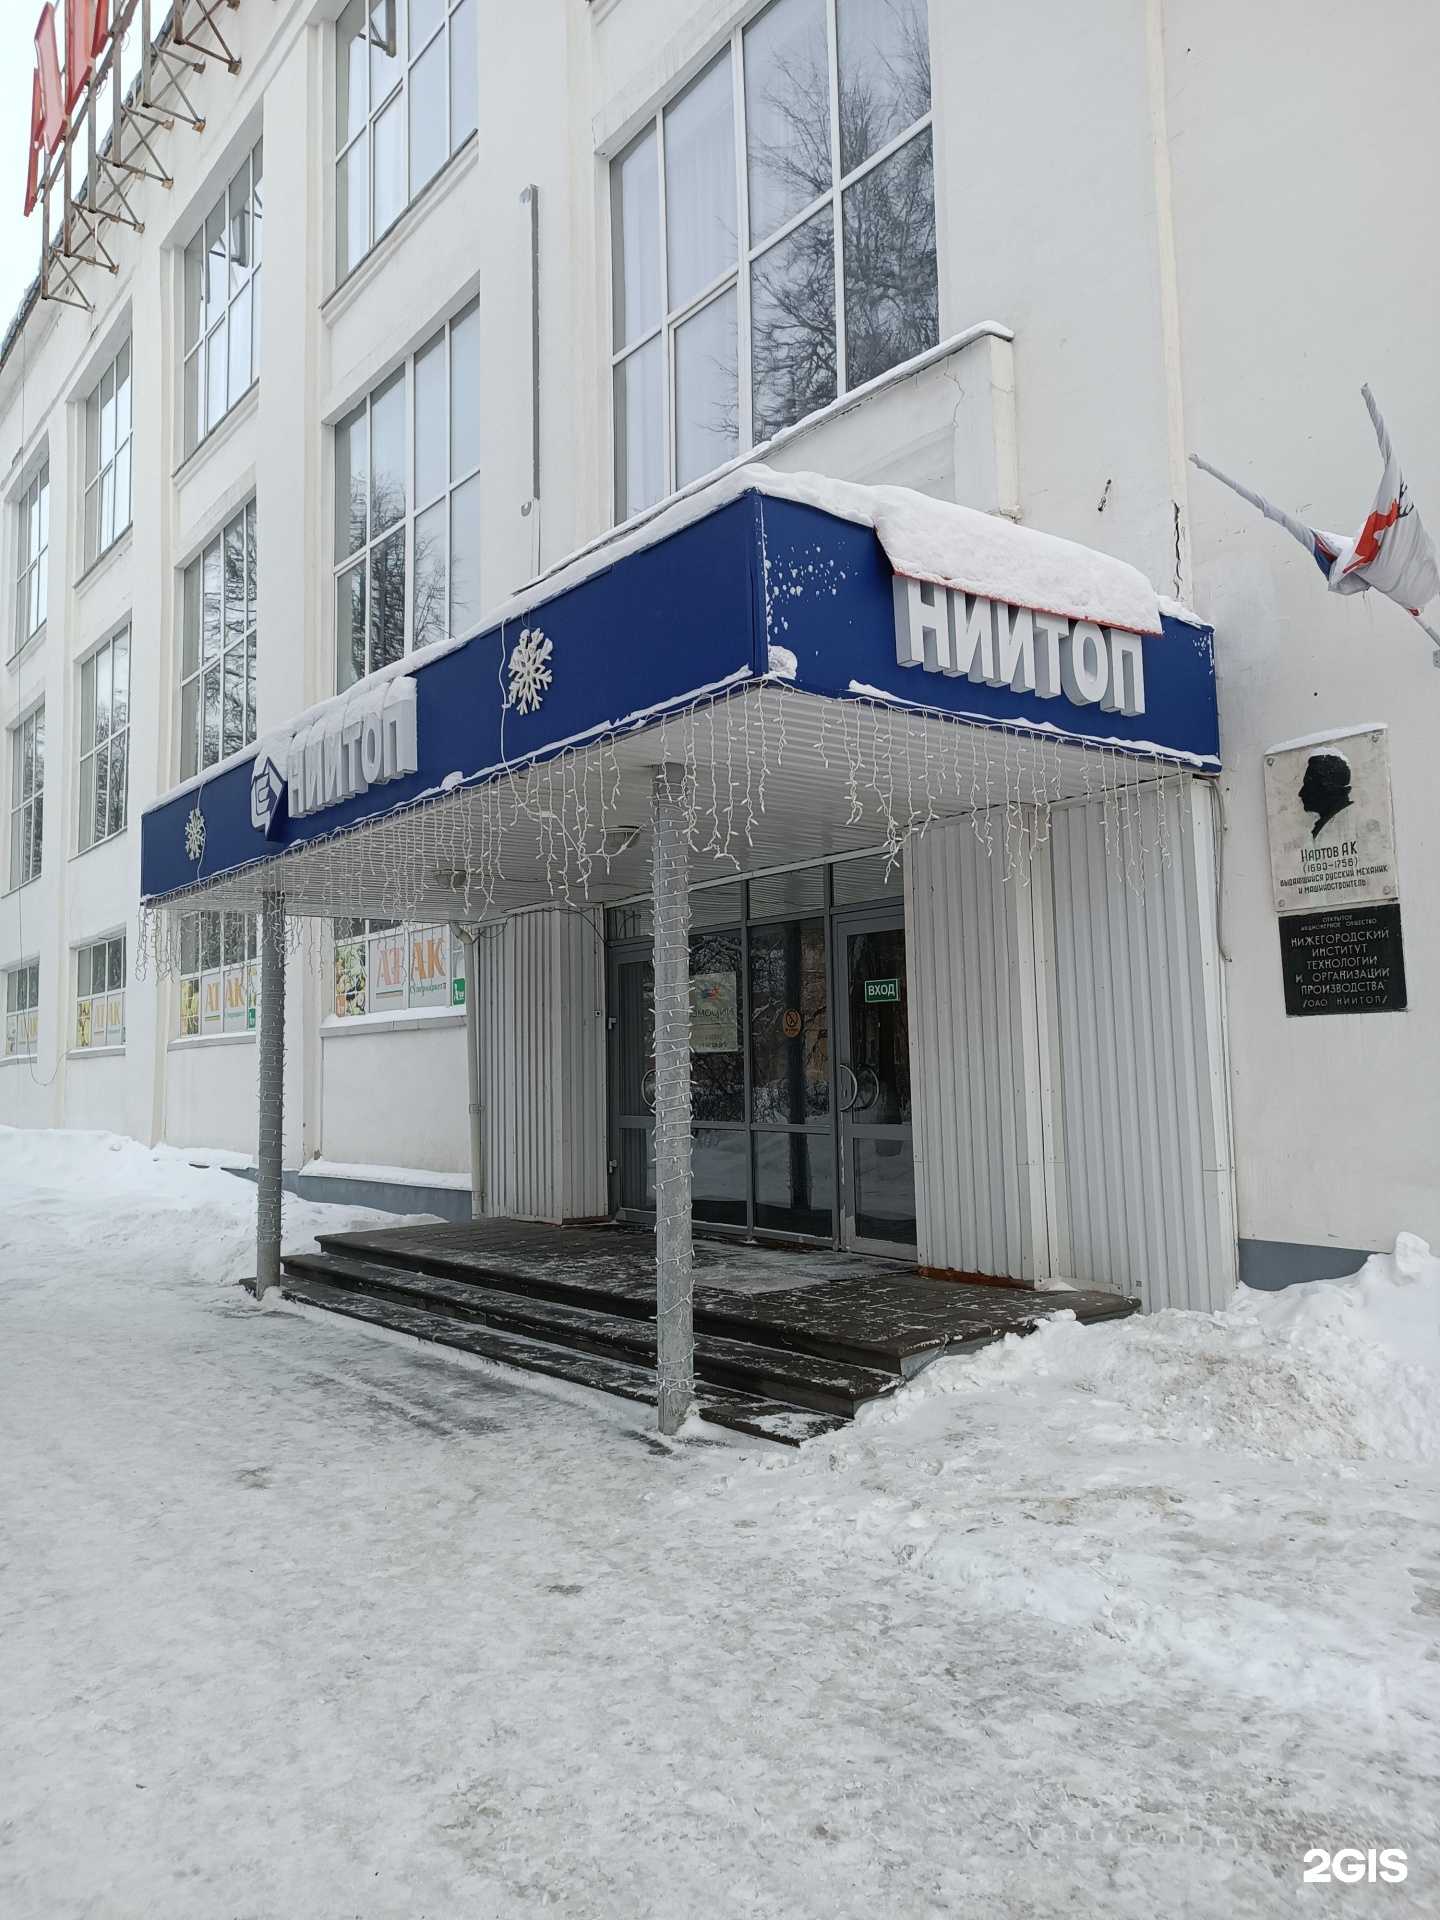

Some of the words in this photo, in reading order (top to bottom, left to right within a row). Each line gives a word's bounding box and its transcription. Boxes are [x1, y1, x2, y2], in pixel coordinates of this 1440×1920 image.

[892, 574, 1146, 717] НИИТОП
[287, 692, 418, 819] НИИТОП
[1301, 846, 1339, 862] НАРТОВ
[1356, 865, 1388, 877] МЕХАНИК
[1291, 929, 1390, 947] НИЖЕГОРОДСКИЙ
[1312, 943, 1367, 957] ИНСТИТУТ
[1306, 955, 1377, 970] ТЕХНОЛОГИИ
[1295, 974, 1303, 983] И
[1312, 967, 1390, 982] ОРГАНИЗАЦИИ
[868, 983, 896, 997] ВХОД
[1301, 980, 1385, 996] ПРОИЗВОДСТВА
